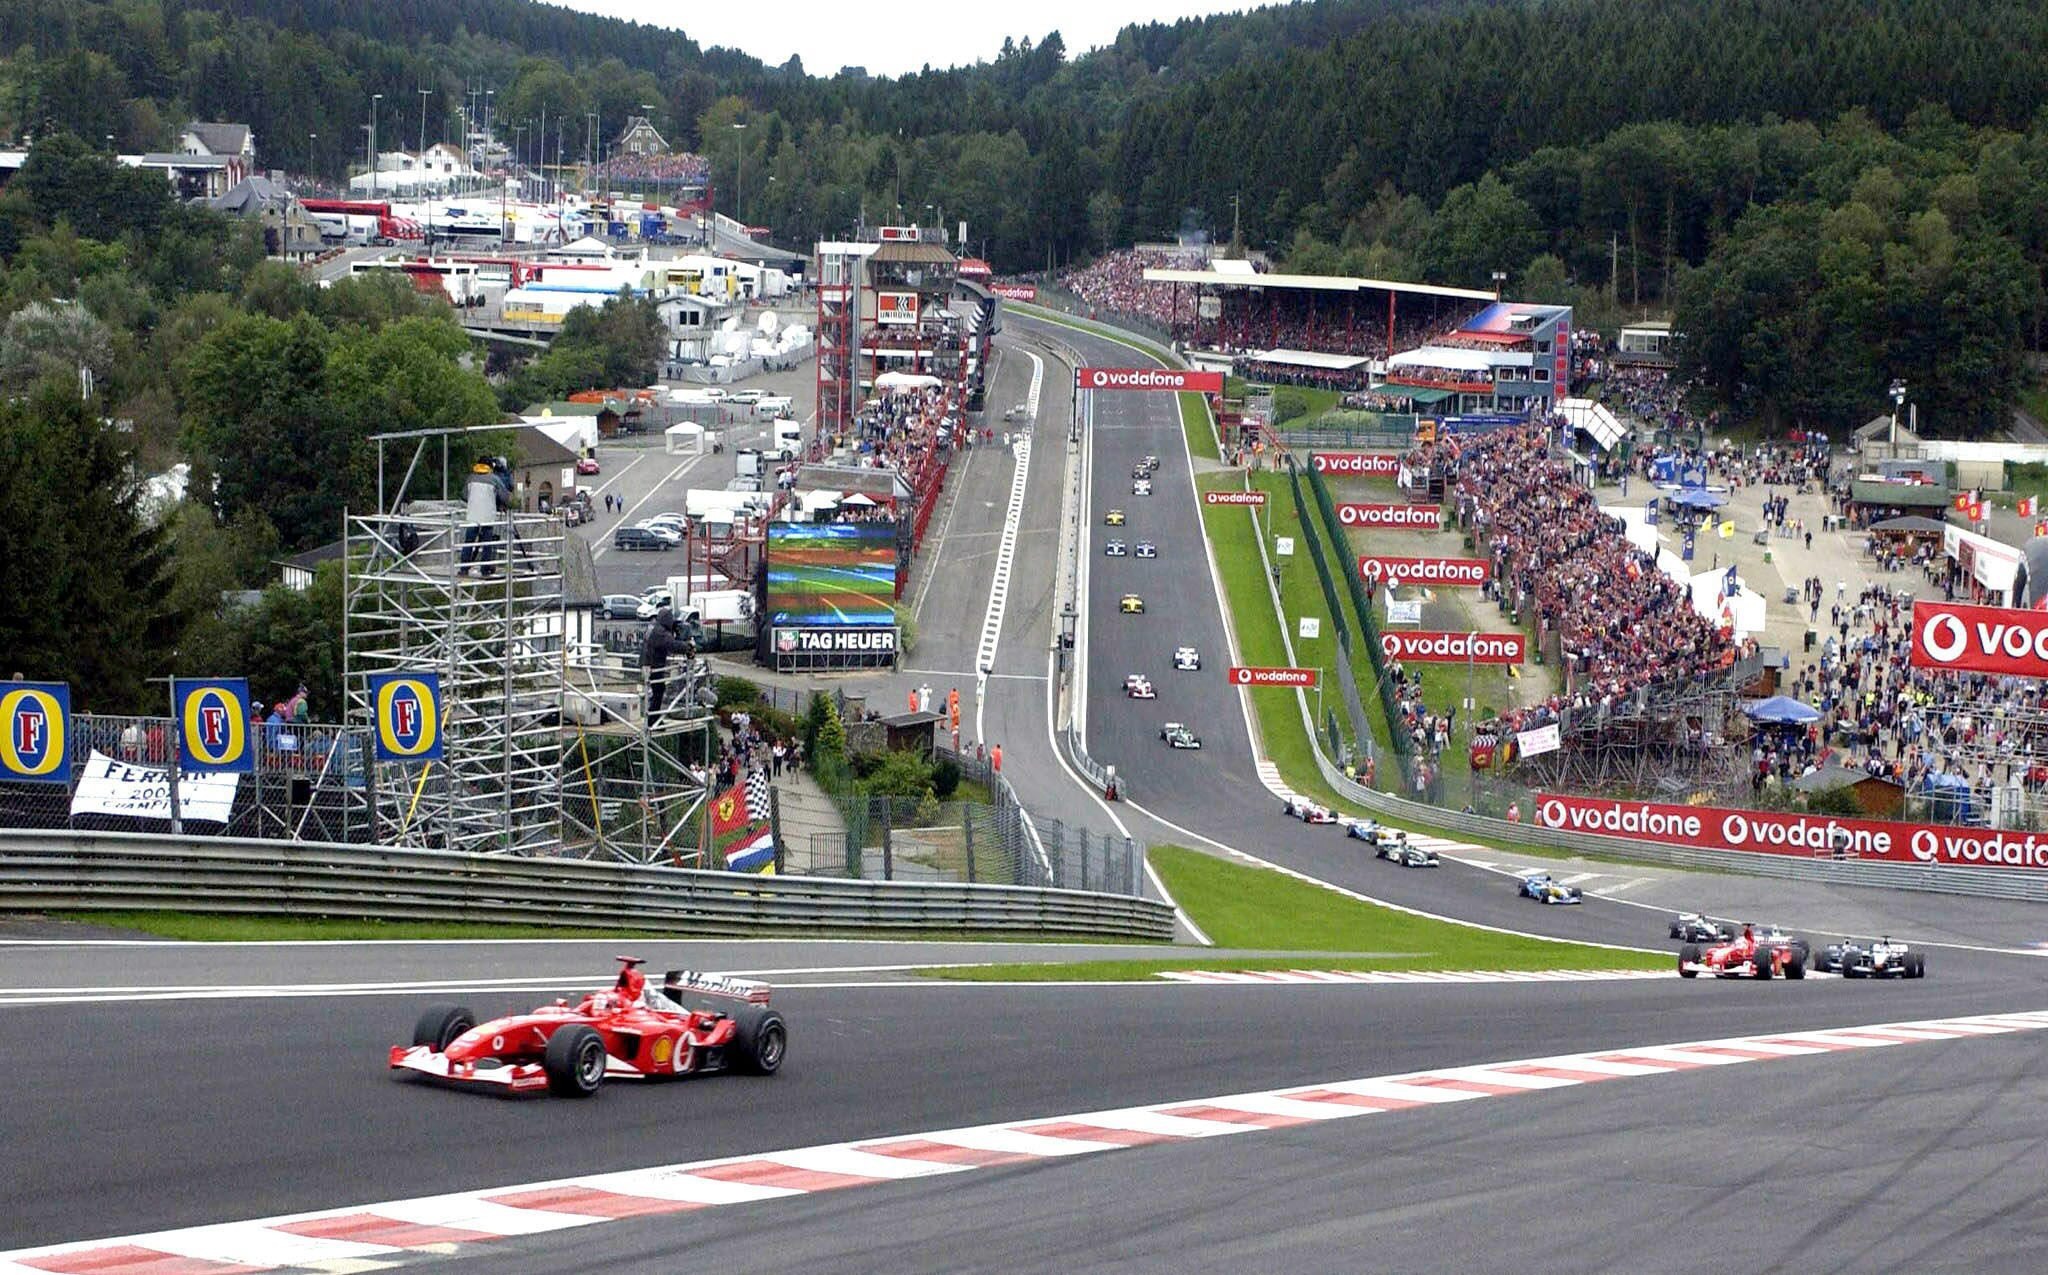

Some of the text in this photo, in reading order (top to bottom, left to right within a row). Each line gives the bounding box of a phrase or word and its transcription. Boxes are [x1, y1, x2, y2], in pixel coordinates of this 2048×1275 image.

[1109, 371, 1185, 386] vodafone
[1217, 493, 1265, 504] vodafone
[1385, 560, 1484, 579] vodafone
[800, 632, 833, 649] TAG
[835, 632, 894, 649] HEUER
[1404, 633, 1519, 657] vodafone
[1255, 671, 1308, 682] vodafone
[1570, 804, 1701, 837] vodafone
